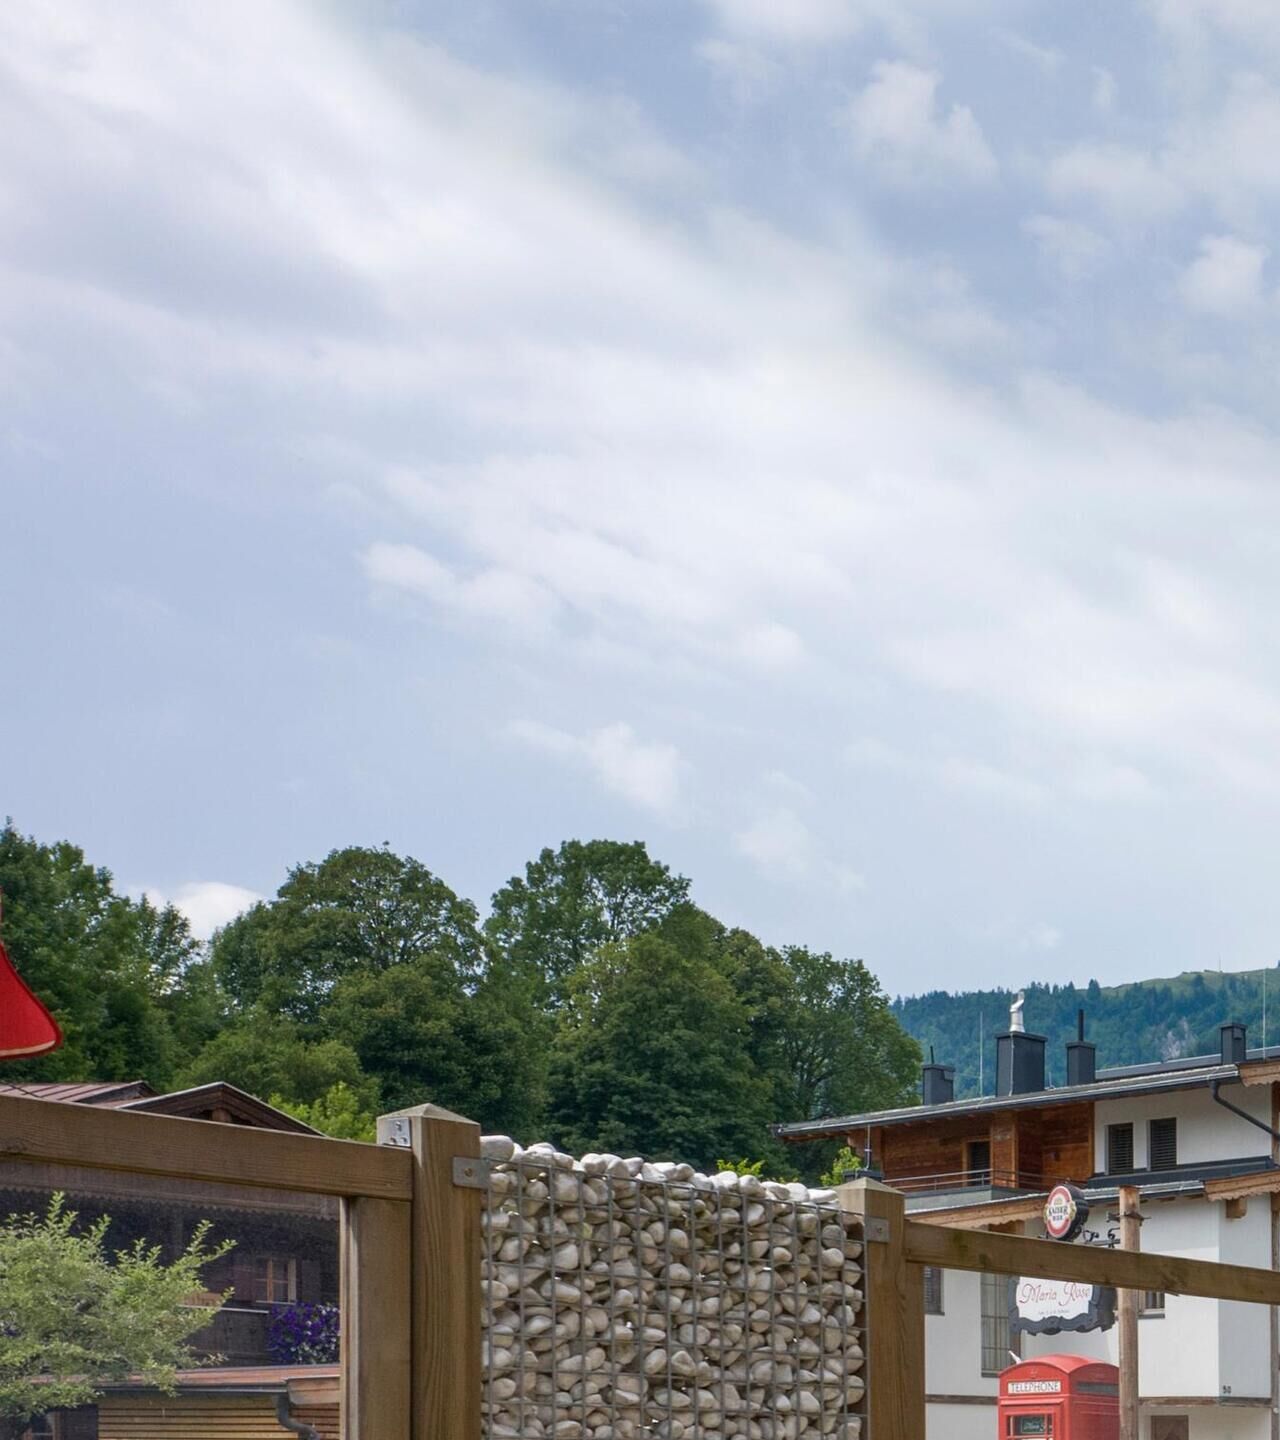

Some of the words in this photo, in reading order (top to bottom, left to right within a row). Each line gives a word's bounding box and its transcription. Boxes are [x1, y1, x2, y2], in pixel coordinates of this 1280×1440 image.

[1019, 1283, 1057, 1304] Maria
[1059, 1282, 1090, 1306] Rose
[1011, 1382, 1060, 1392] TELEPHONE
